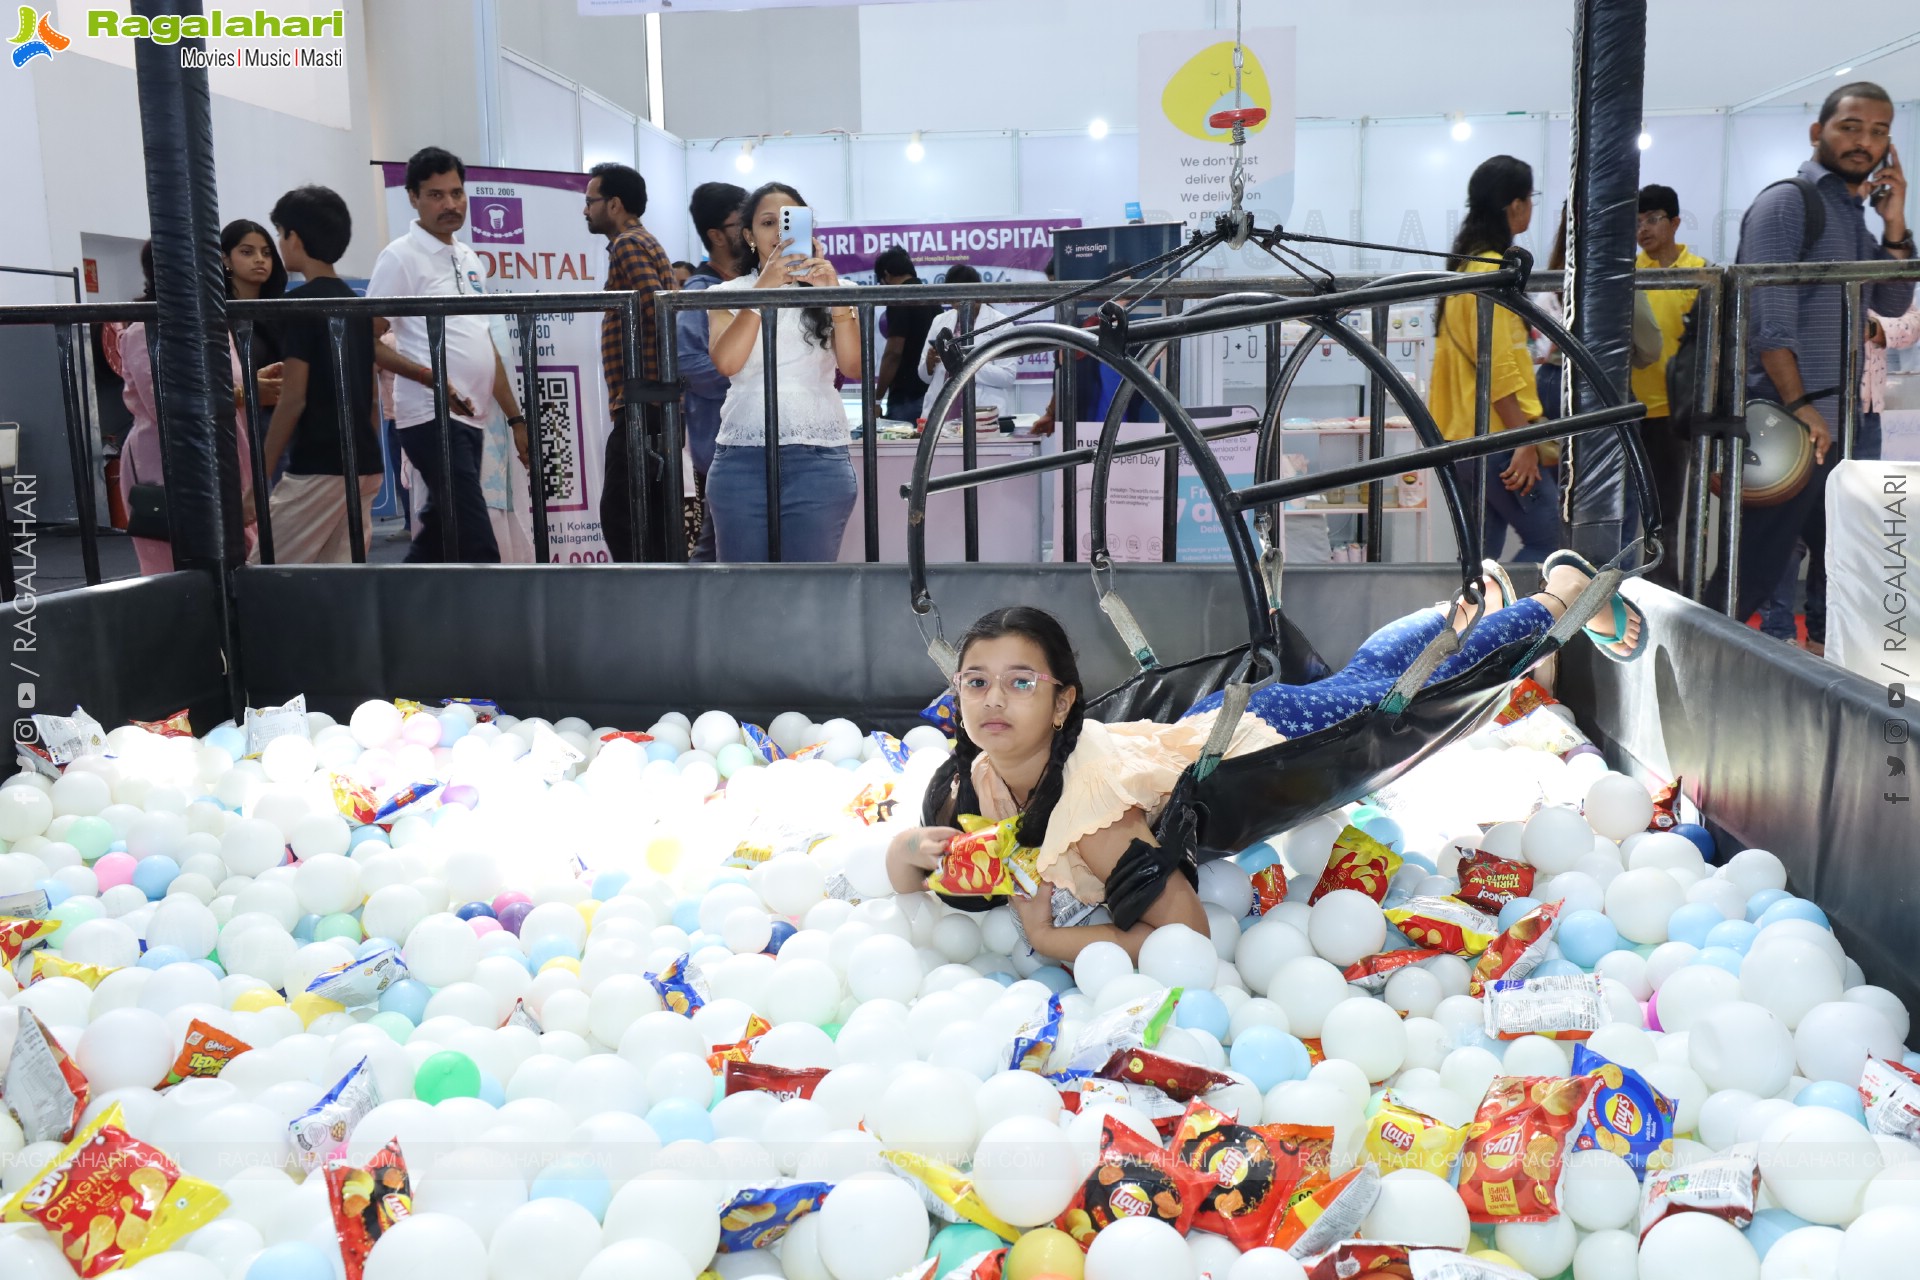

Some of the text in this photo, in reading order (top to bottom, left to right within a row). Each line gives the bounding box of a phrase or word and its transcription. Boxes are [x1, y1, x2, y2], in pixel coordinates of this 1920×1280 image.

[1180, 155, 1259, 167] We don't ust
[1185, 174, 1225, 185] deliver
[476, 186, 515, 197] ESTD. 2005
[1180, 191, 1261, 202] We deliv on
[1189, 211, 1197, 220] a
[817, 233, 855, 257] SIRI
[864, 230, 949, 255] DENTAL
[1075, 243, 1108, 254] invisalign
[476, 250, 595, 281] DENTAL
[536, 325, 551, 338] 3D
[1140, 453, 1161, 467] Day
[567, 521, 602, 532] Kokape
[1200, 525, 1224, 534] Deliv
[1469, 876, 1520, 888] THRILLING
[1486, 872, 1520, 882] TOMATO
[1612, 1094, 1635, 1134] Lay's
[1381, 1121, 1414, 1148] Lay's
[1482, 1132, 1521, 1157] Lay's
[1111, 1185, 1151, 1216] Lay's
[1489, 1194, 1511, 1203] MORE
